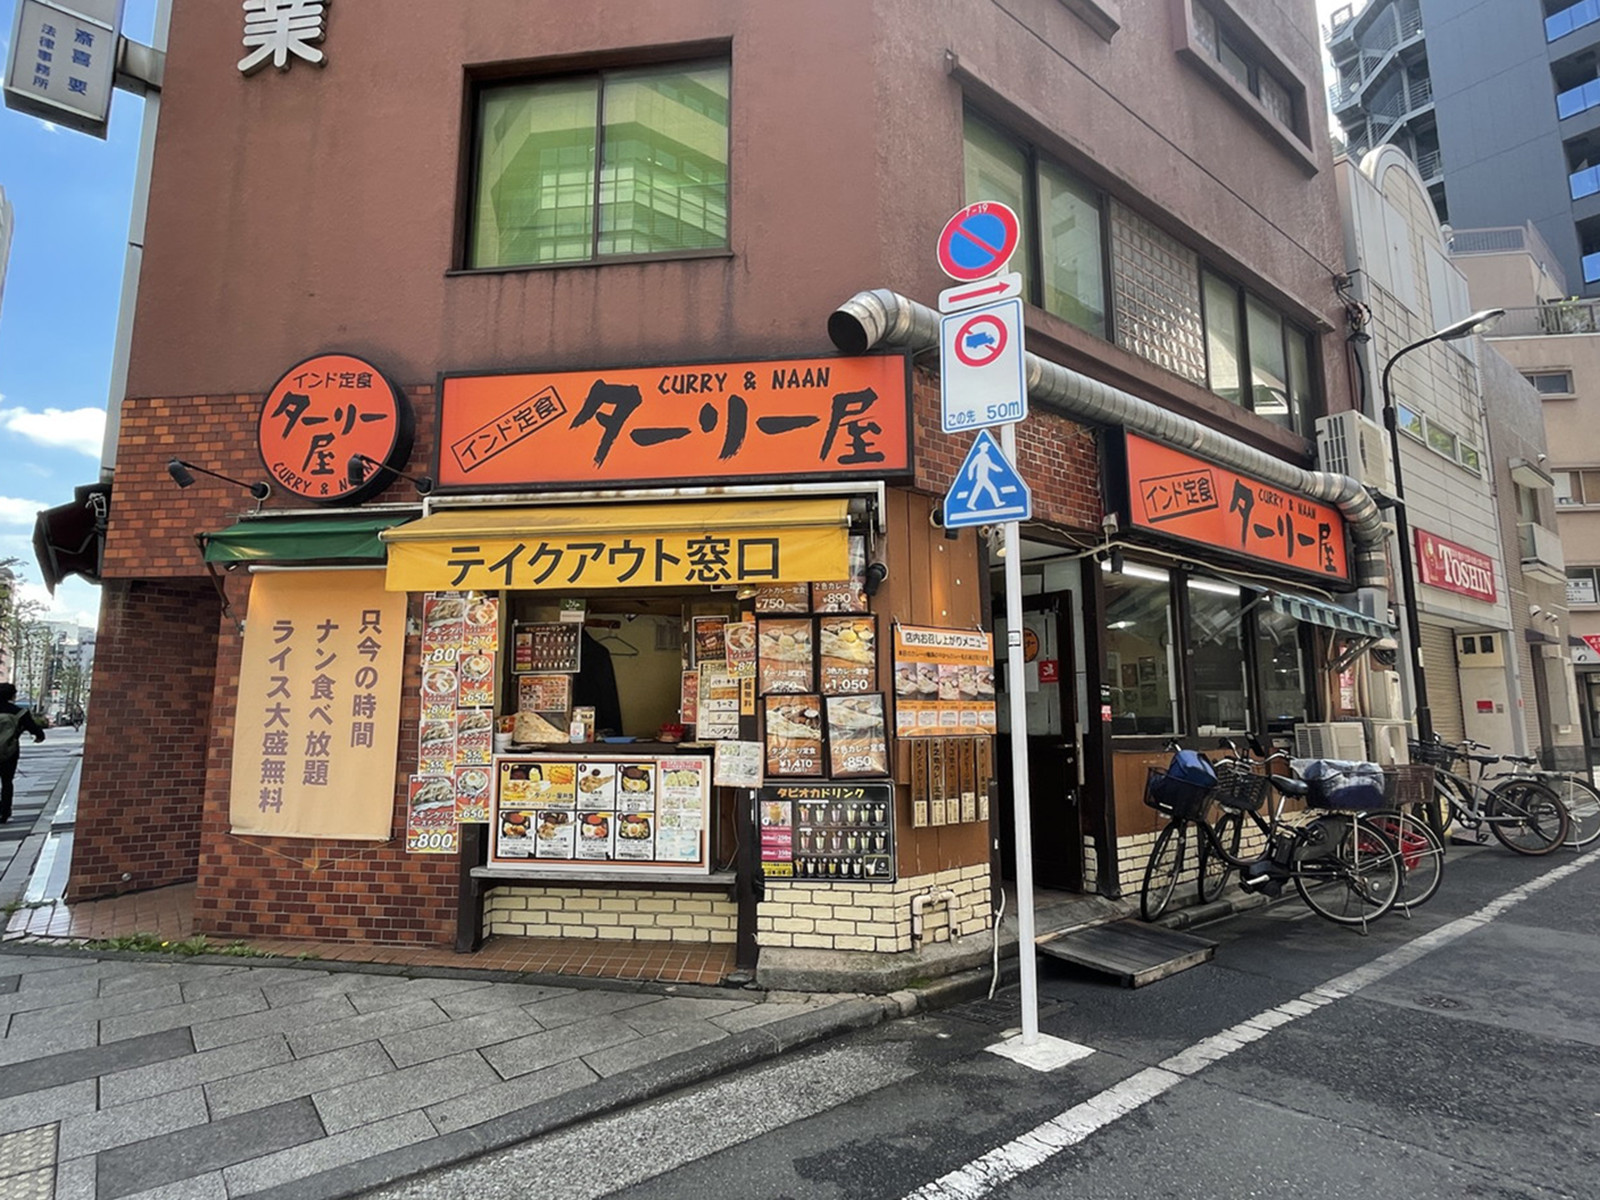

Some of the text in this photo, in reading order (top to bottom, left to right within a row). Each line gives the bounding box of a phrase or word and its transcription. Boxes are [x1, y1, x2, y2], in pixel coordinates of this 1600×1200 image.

[33, 23, 56, 90] 法律事務所
[965, 203, 989, 217] 7-19
[293, 372, 373, 388] インド定食
[657, 367, 831, 396] CURRY & NAAN
[271, 391, 388, 440] ターリー
[461, 394, 560, 463] インド定食
[569, 378, 886, 470] ターリー屋
[948, 401, 1020, 426] この先 50m
[272, 462, 312, 493] CURRY
[1146, 477, 1213, 513] インド定食
[1229, 478, 1337, 574] ターリー屋
[1258, 488, 1284, 508] CURRY
[1297, 503, 1317, 520] NAAN
[447, 536, 780, 588] テイクアウト窓口
[1438, 543, 1493, 596] TOSHIN
[302, 618, 339, 786] ナン食べ放題
[350, 609, 382, 748] 只今の時間
[258, 620, 294, 814] ライス大盛無料
[776, 788, 865, 799] タピオカドリンク
[411, 833, 454, 850] ¥800
